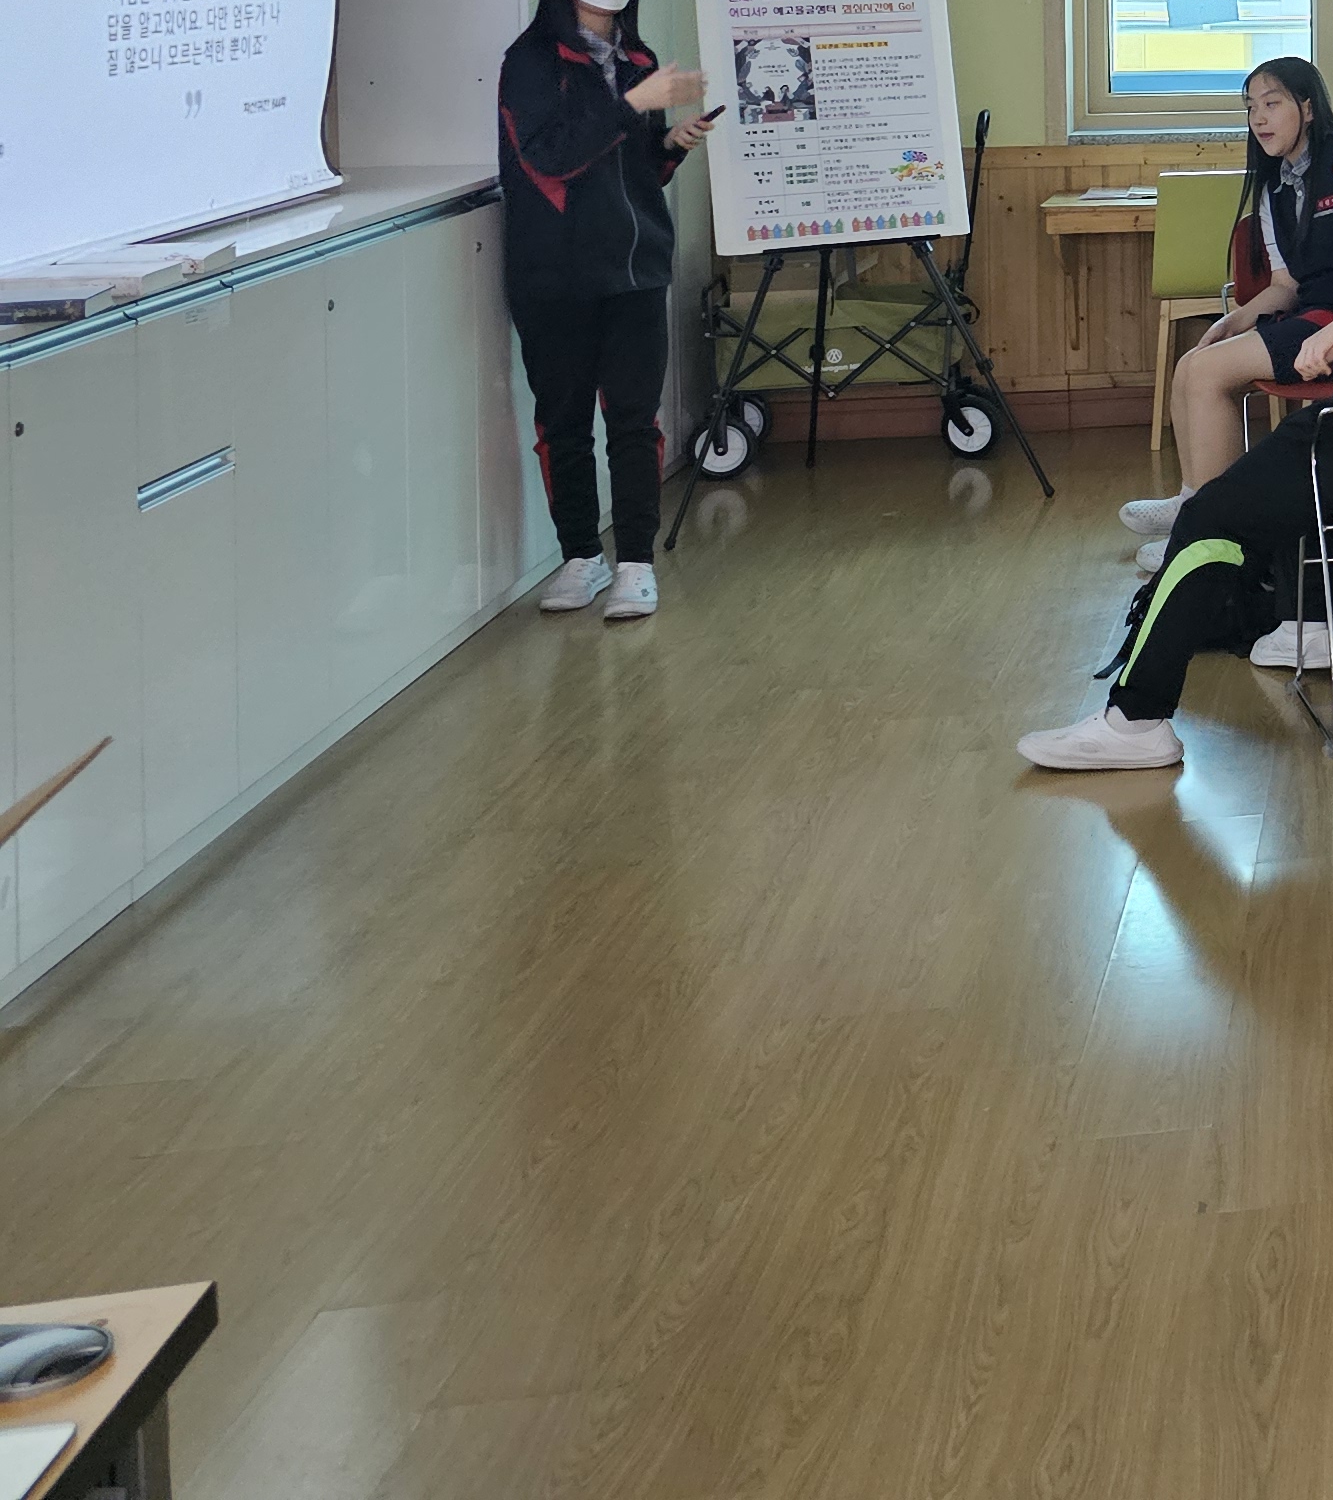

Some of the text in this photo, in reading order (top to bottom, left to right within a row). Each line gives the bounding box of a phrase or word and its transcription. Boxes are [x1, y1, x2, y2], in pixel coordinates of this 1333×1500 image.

[107, 13, 133, 42] 답을
[207, 5, 228, 32] 다만
[233, 2, 266, 29] 엄두가
[270, 1, 281, 24] 나
[125, 44, 162, 74] 않으니
